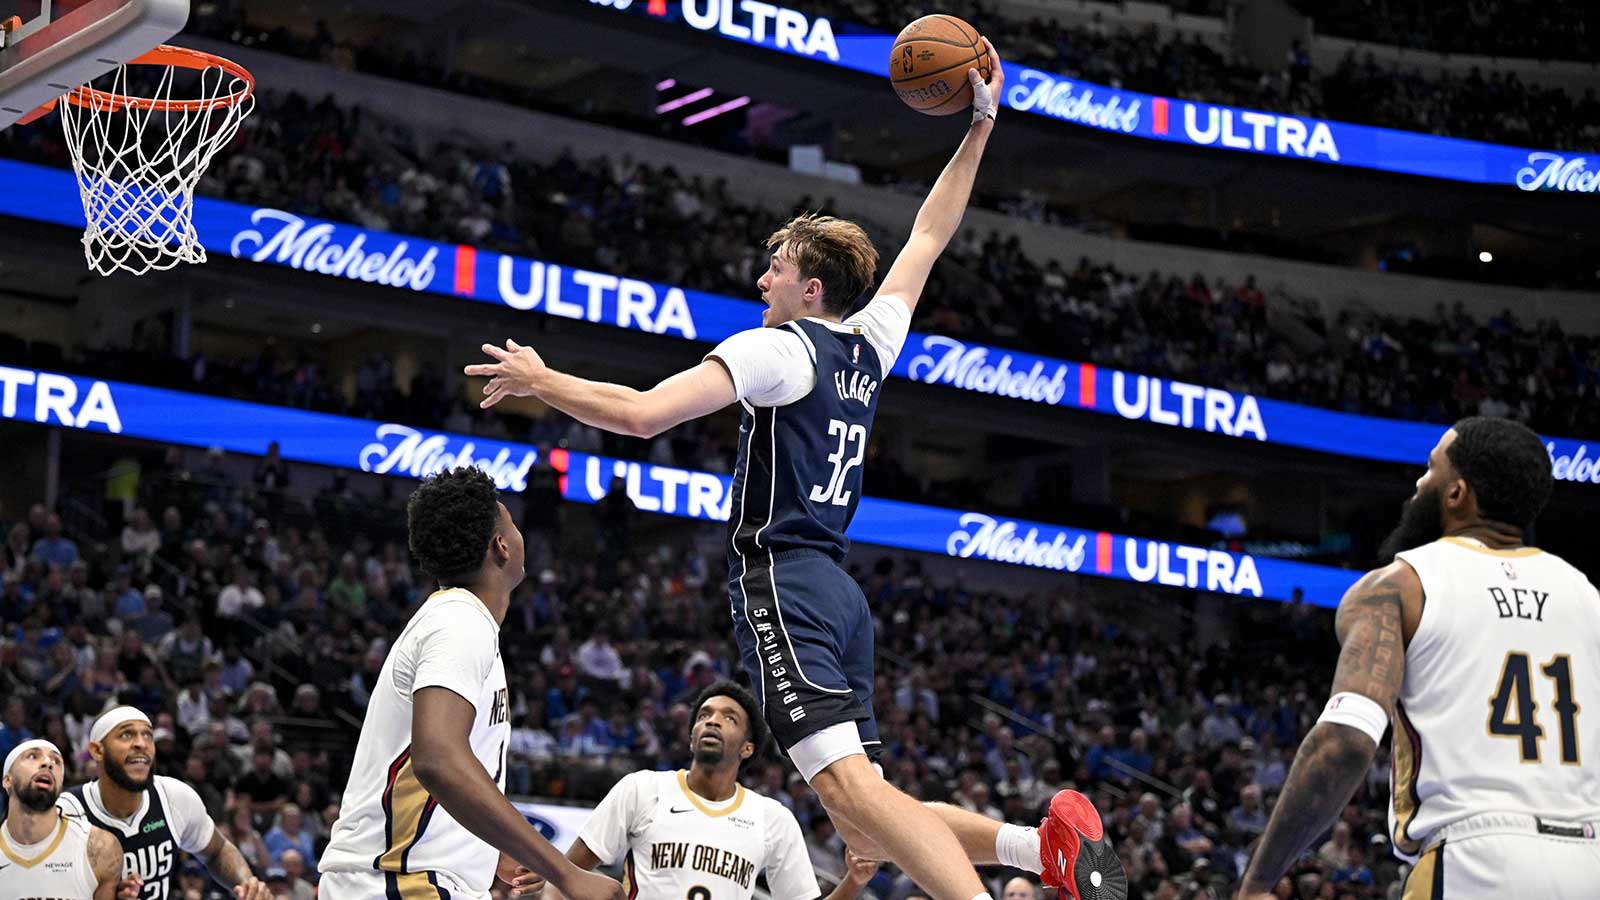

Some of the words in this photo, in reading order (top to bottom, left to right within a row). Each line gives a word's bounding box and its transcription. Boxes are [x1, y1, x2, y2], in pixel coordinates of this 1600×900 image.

[682, 0, 840, 61] ULTRA
[1007, 69, 1141, 133] Michelob
[1184, 104, 1340, 161] ULTRA
[230, 208, 439, 291] Michelob
[497, 255, 697, 340] ULTRA
[0, 366, 122, 433] TRA
[834, 369, 877, 408] FLAGG
[908, 335, 1068, 405] Michelob
[1112, 371, 1267, 441] ULTRA
[809, 418, 867, 507] 32
[946, 512, 1087, 572] Michelob
[1125, 538, 1263, 597] ULTRA
[1487, 587, 1549, 622] BEY
[1485, 649, 1581, 767] 41
[651, 842, 690, 870] NEW
[692, 844, 754, 891] ORLEANS
